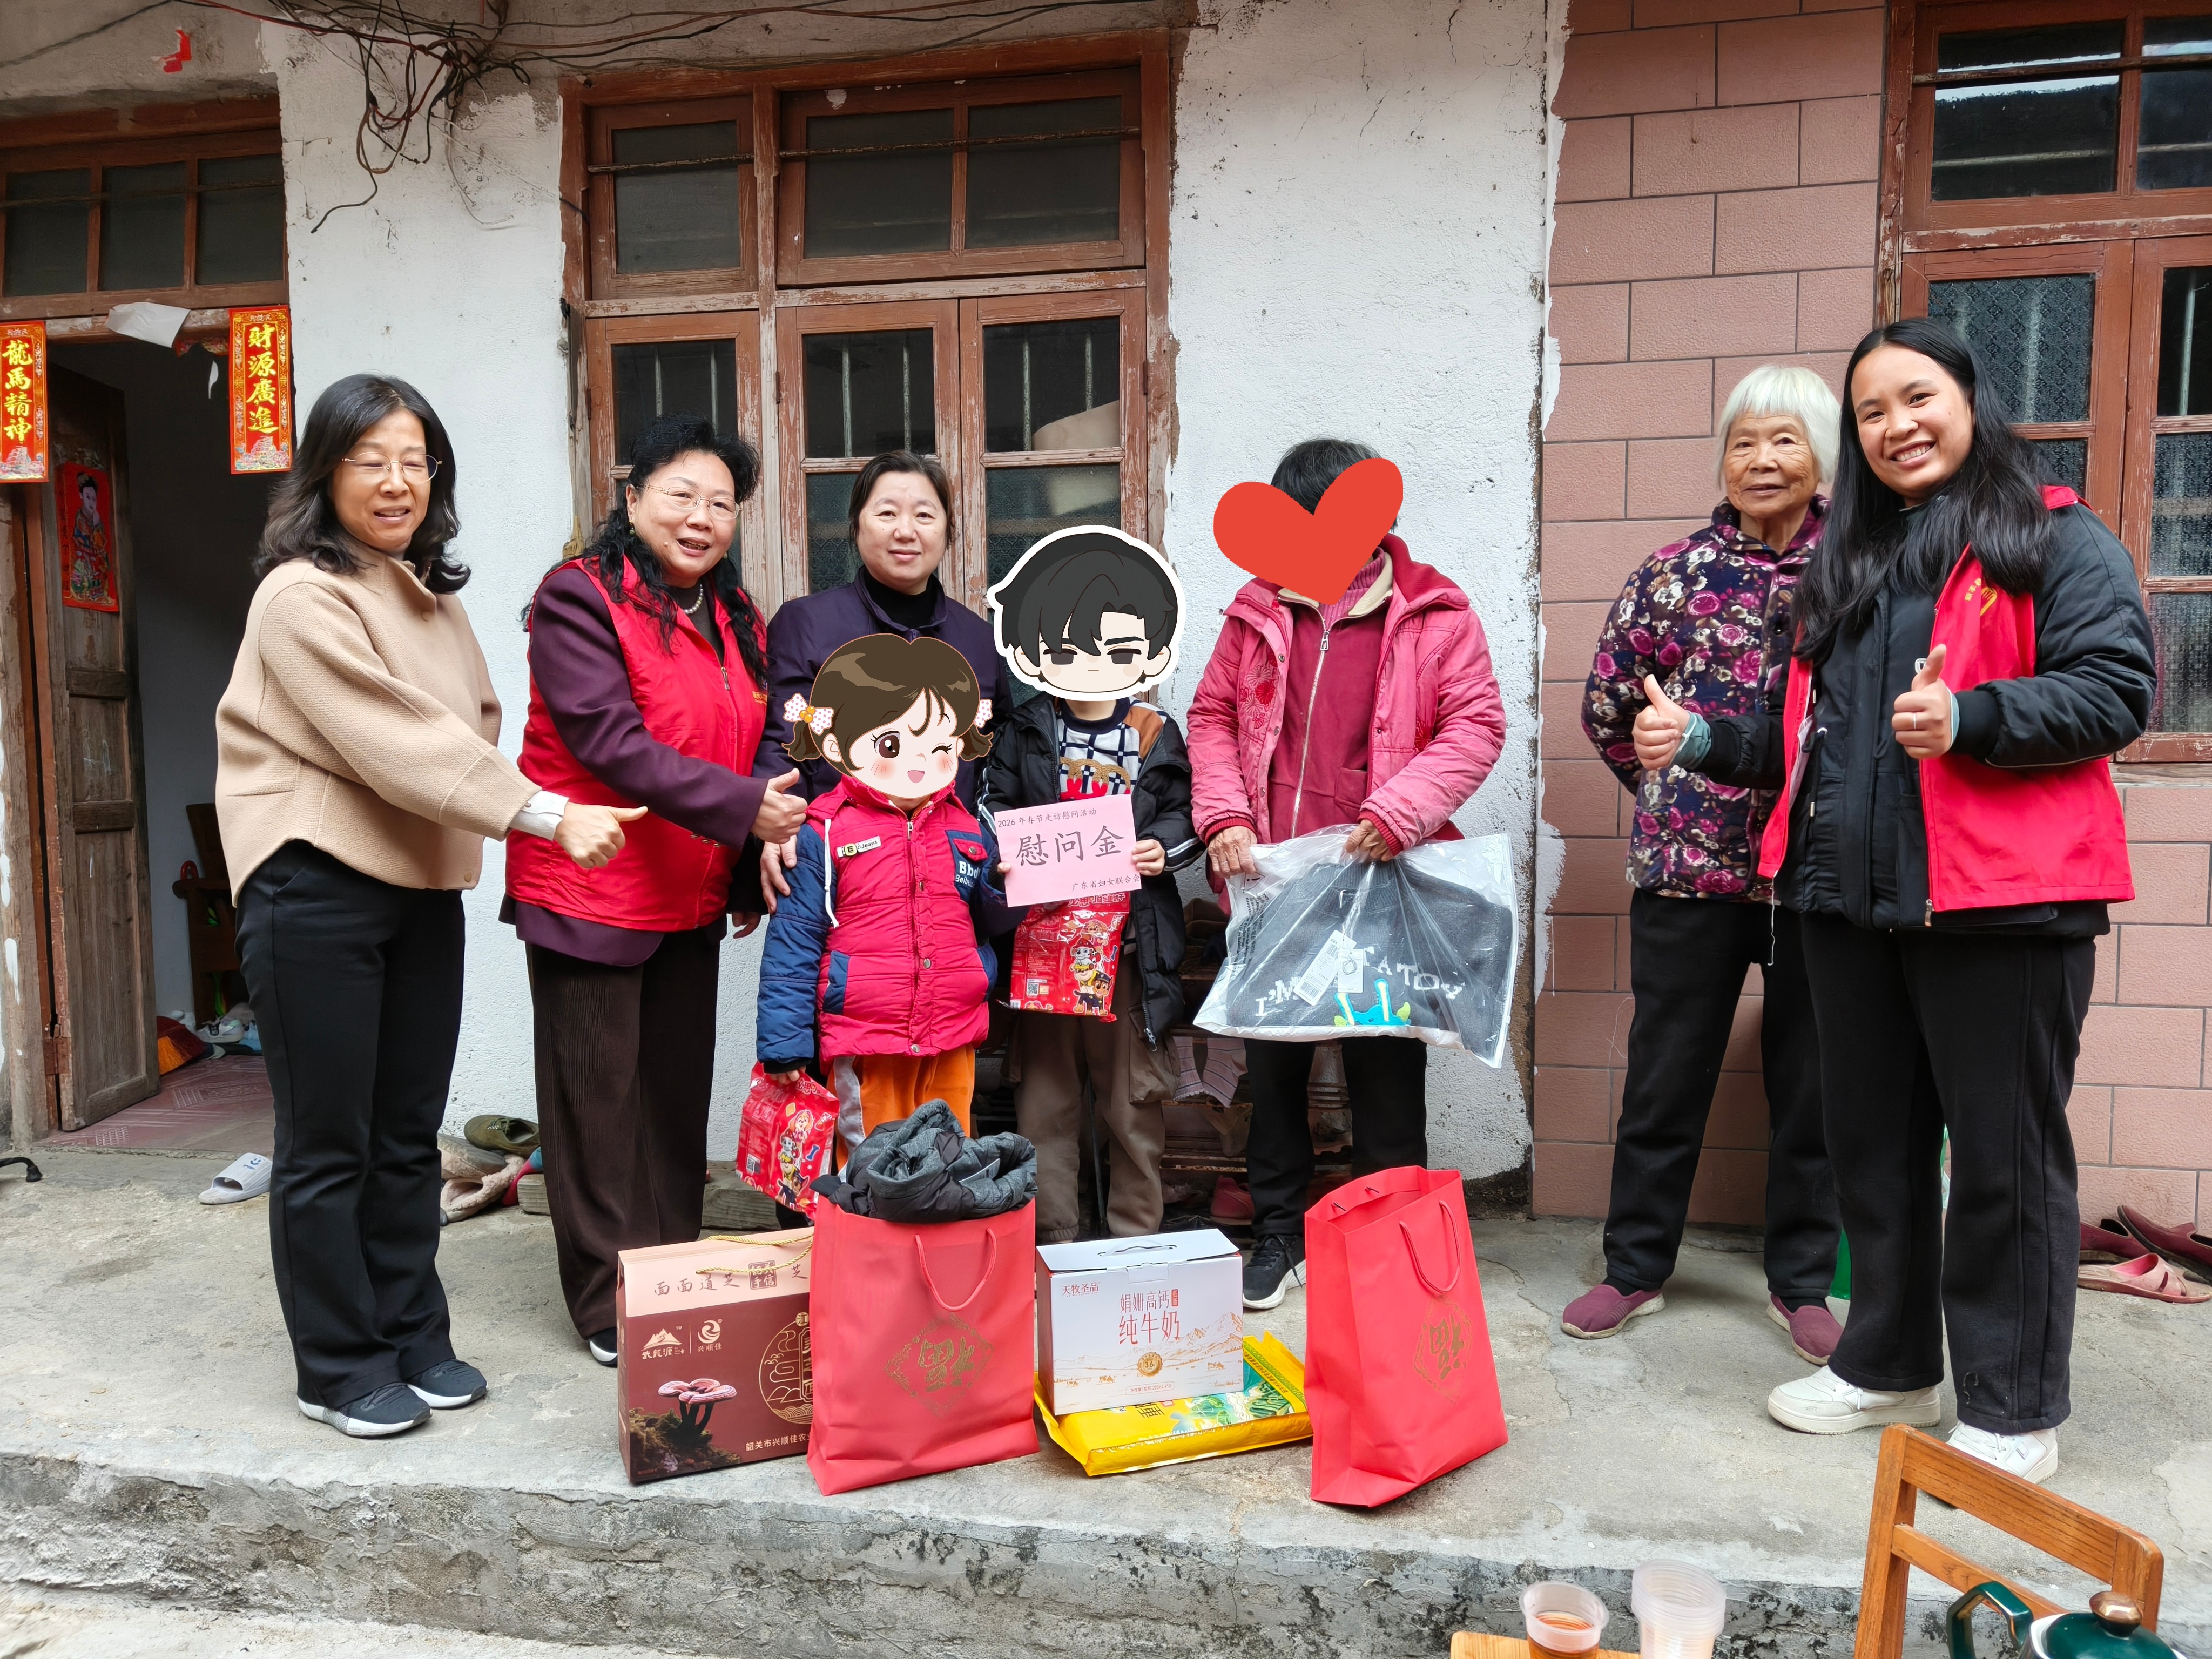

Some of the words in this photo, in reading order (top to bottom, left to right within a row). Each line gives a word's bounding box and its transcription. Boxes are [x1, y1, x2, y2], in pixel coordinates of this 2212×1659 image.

[246, 323, 279, 434] 財源廣進
[2, 339, 33, 444] 龍馬精神
[998, 819, 1016, 827] 2026
[1018, 808, 1096, 826] 年春节走访慰问活动
[861, 840, 878, 848] Jeans
[1016, 825, 1125, 866] 慰问金
[1072, 874, 1139, 891] 广东省妇女联合会
[1371, 955, 1393, 975] A
[654, 1273, 740, 1296] 面面道芝
[791, 1264, 808, 1279] 芝
[753, 1274, 774, 1288] 手信
[1062, 1282, 1098, 1296] 天牧圣品
[1120, 1290, 1170, 1313] 娟姗高钙
[796, 1314, 807, 1325] 江
[1119, 1310, 1179, 1345] 纯牛奶
[697, 1342, 723, 1353] 兴顺佳
